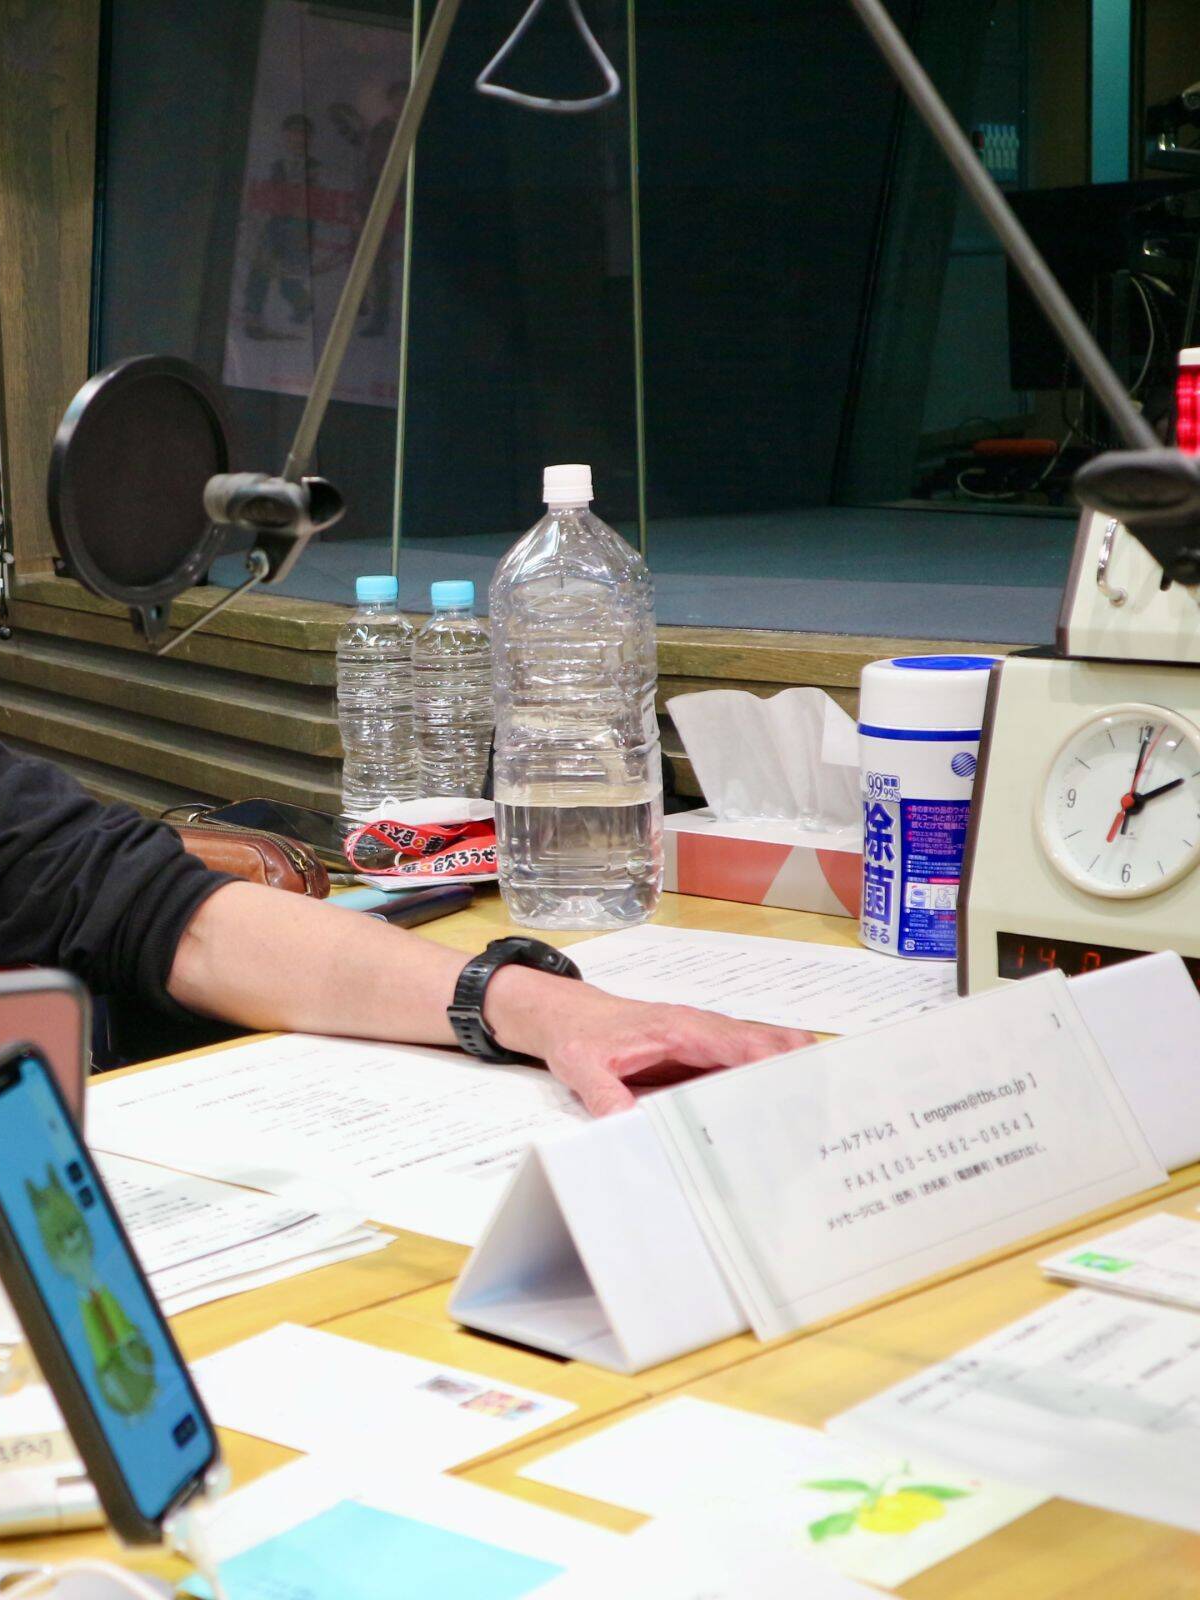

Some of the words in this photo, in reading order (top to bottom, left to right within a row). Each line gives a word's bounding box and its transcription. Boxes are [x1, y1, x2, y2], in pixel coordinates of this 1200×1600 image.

[1066, 788, 1077, 809] 9
[1121, 863, 1132, 884] 6
[1017, 945, 1056, 969] 14
[818, 1122, 898, 1160] メールアドレス
